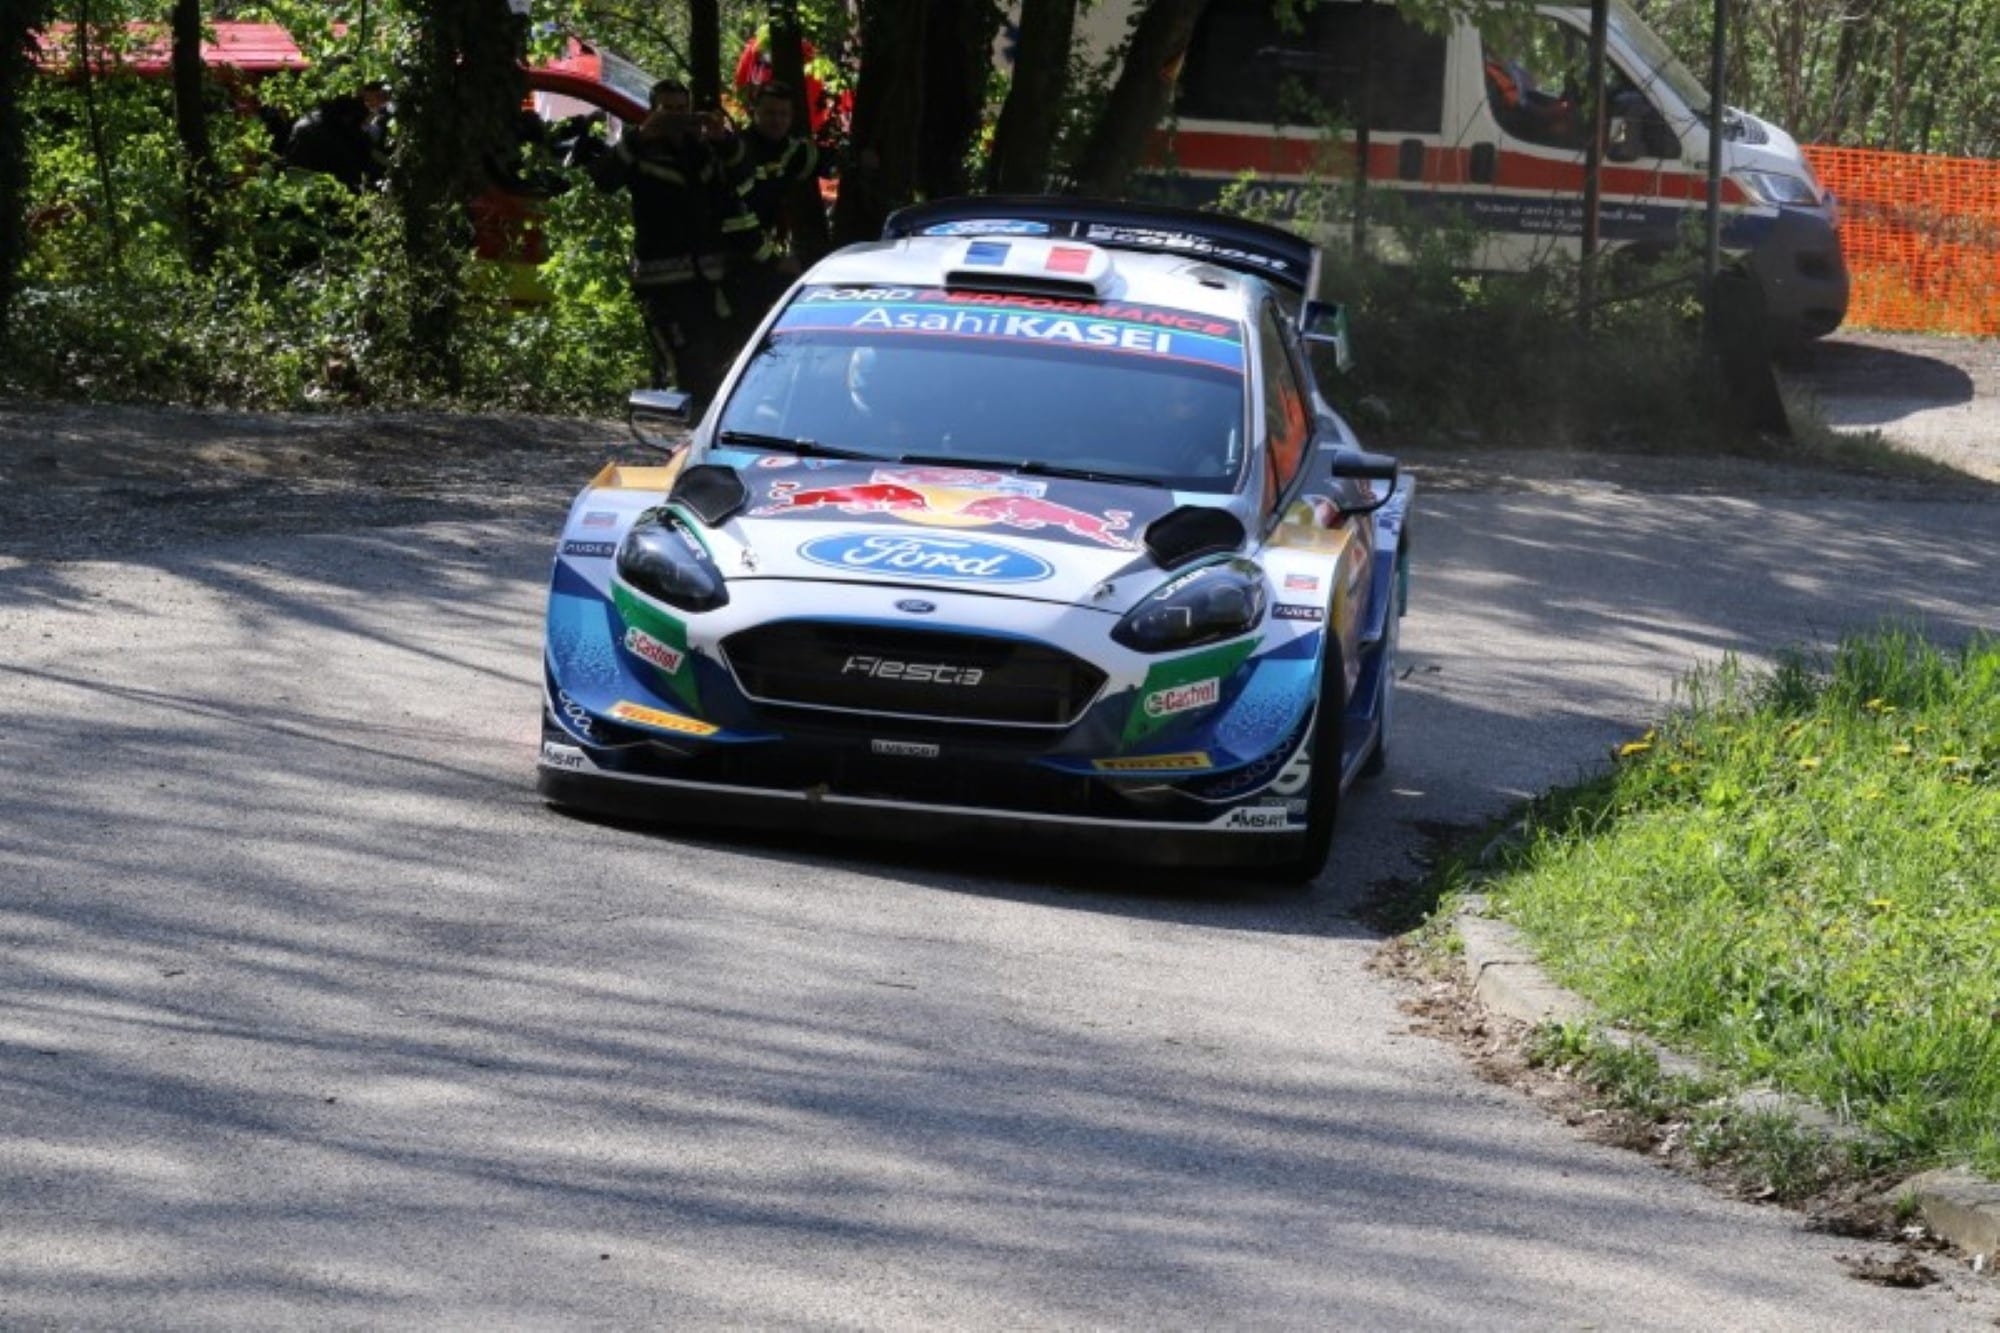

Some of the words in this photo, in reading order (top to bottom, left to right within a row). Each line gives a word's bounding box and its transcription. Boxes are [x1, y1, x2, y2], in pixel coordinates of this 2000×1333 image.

[804, 288, 915, 303] FORD
[918, 289, 1233, 335] PERFORMANCE
[841, 535, 1007, 576] Ford
[635, 633, 680, 670] Castrol
[1163, 682, 1216, 711] Castrol
